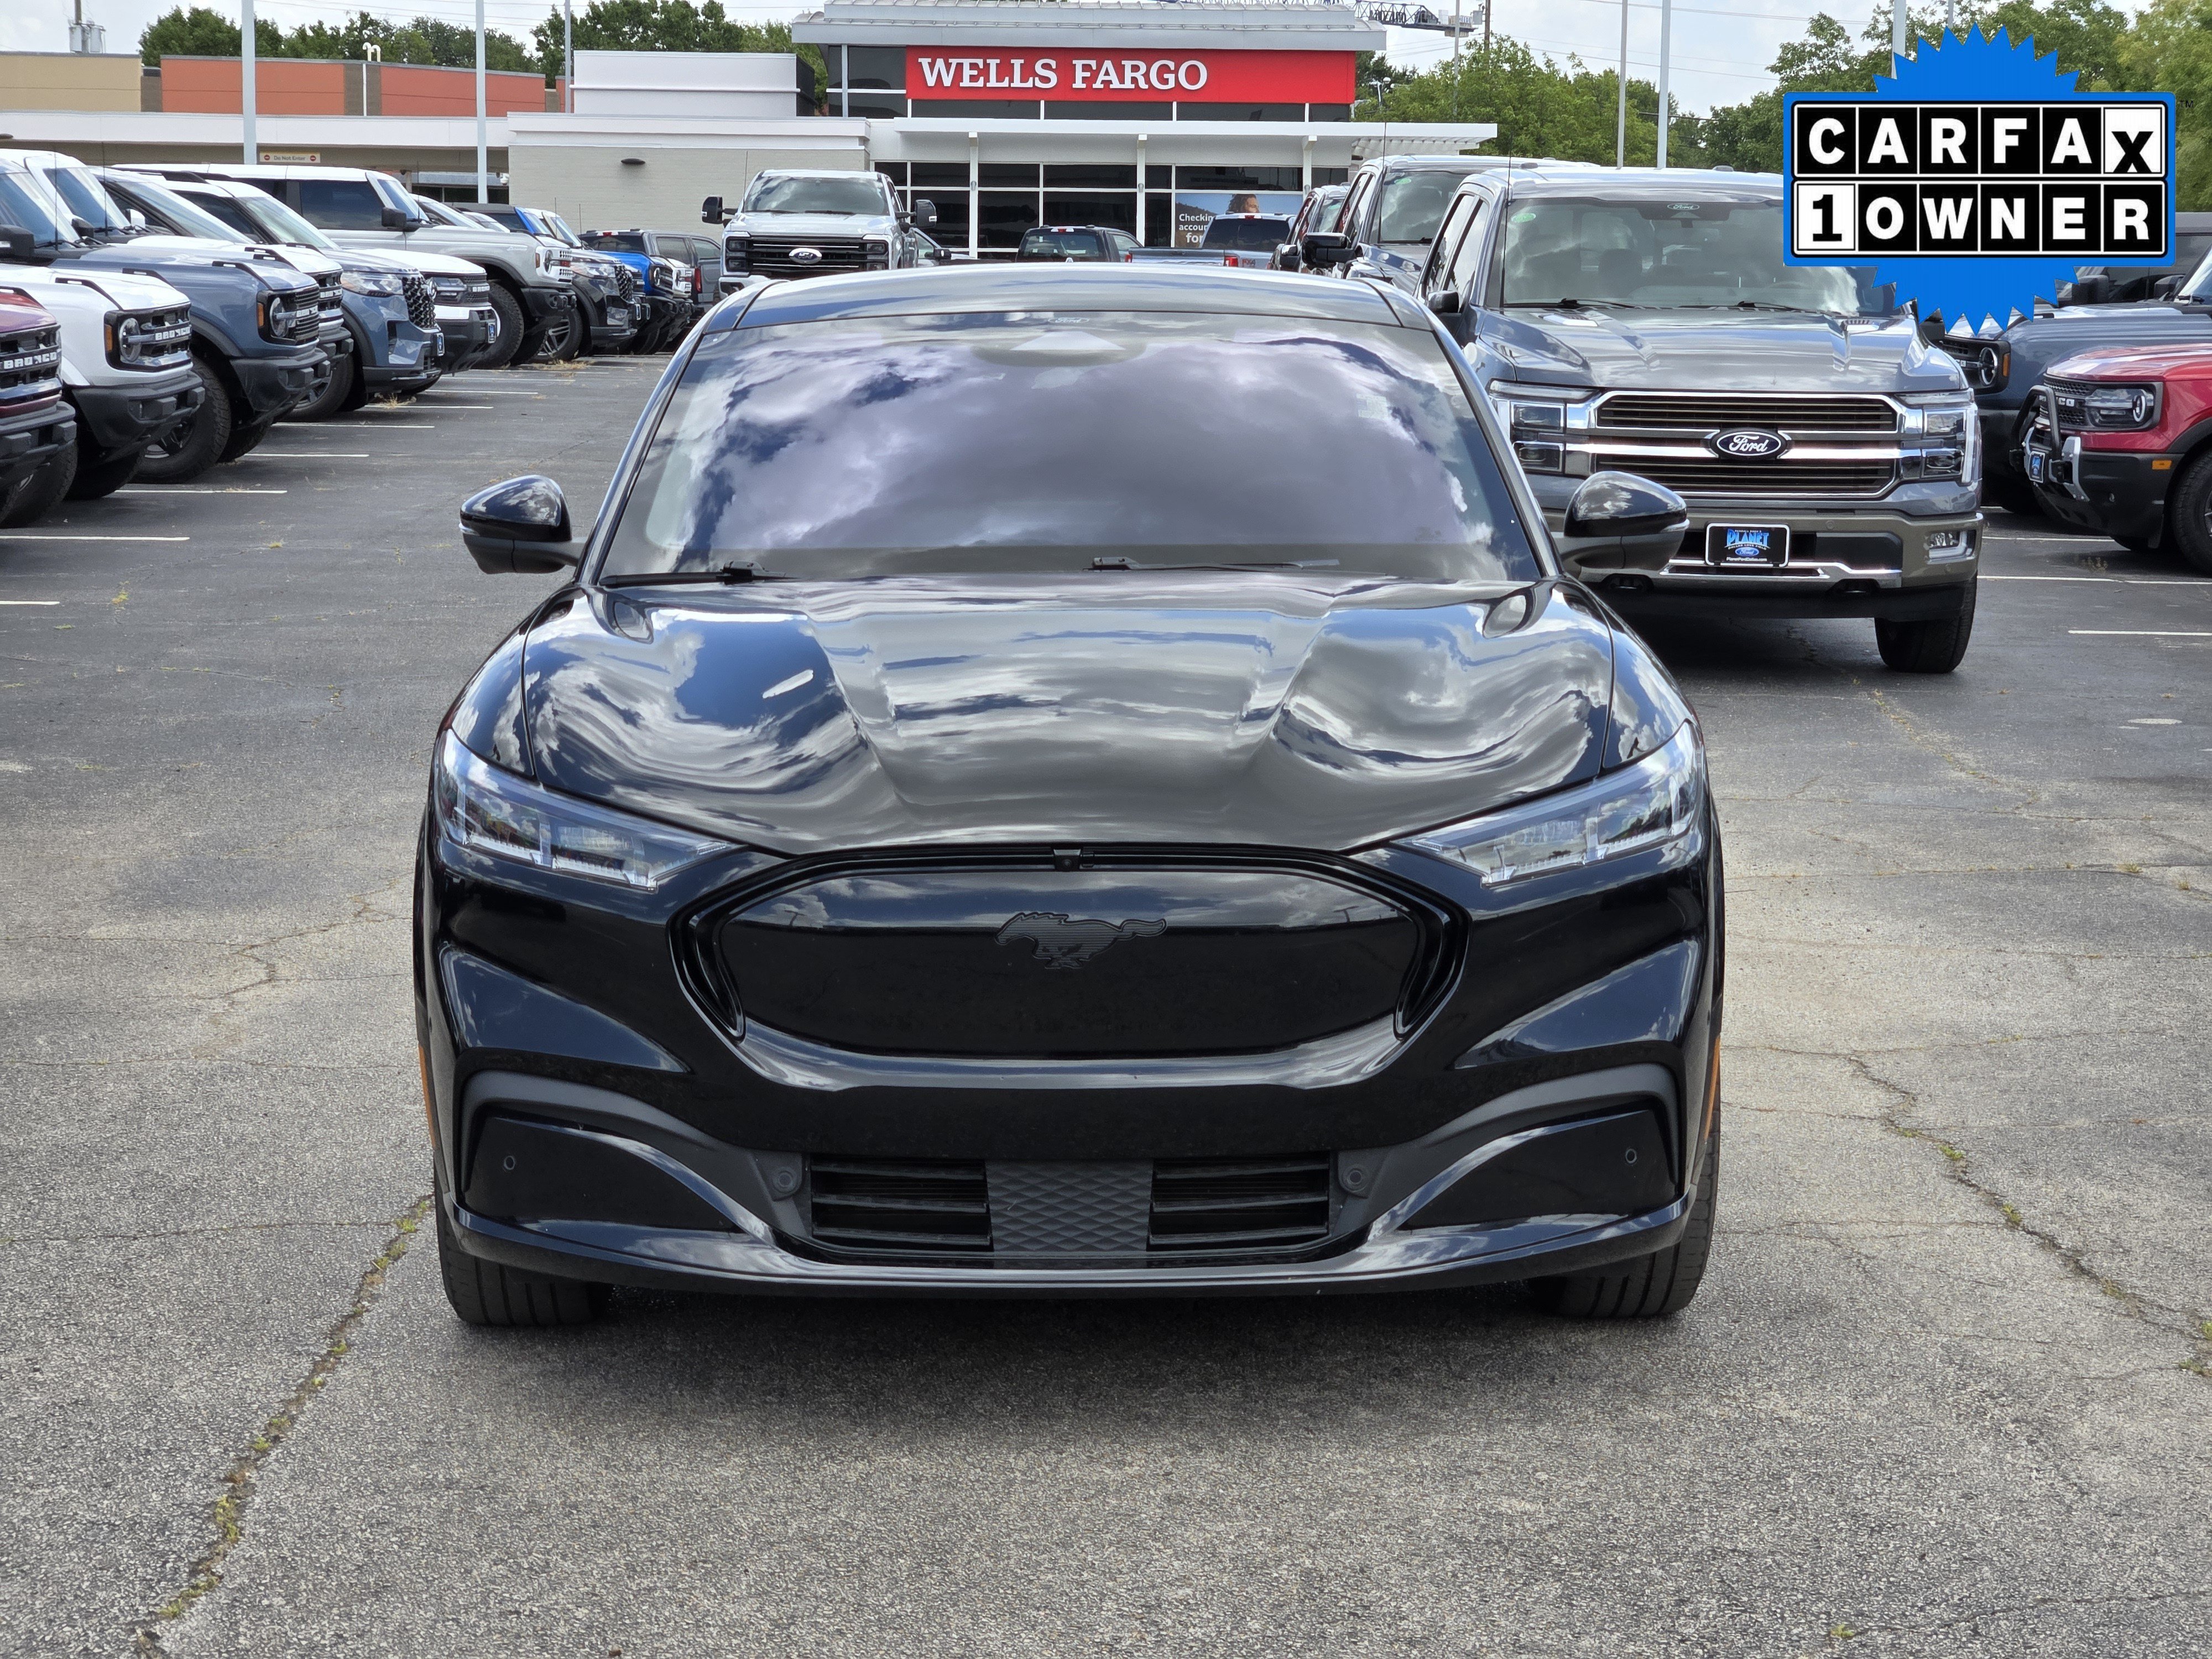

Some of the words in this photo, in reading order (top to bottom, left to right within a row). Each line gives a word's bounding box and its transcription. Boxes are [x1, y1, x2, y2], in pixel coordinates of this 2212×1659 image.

[918, 58, 1057, 88] WELLS
[1072, 60, 1208, 90] FARGO
[3, 352, 57, 369] BRONCO
[1729, 435, 1769, 452] Ford
[1726, 529, 1769, 546] PLANET
